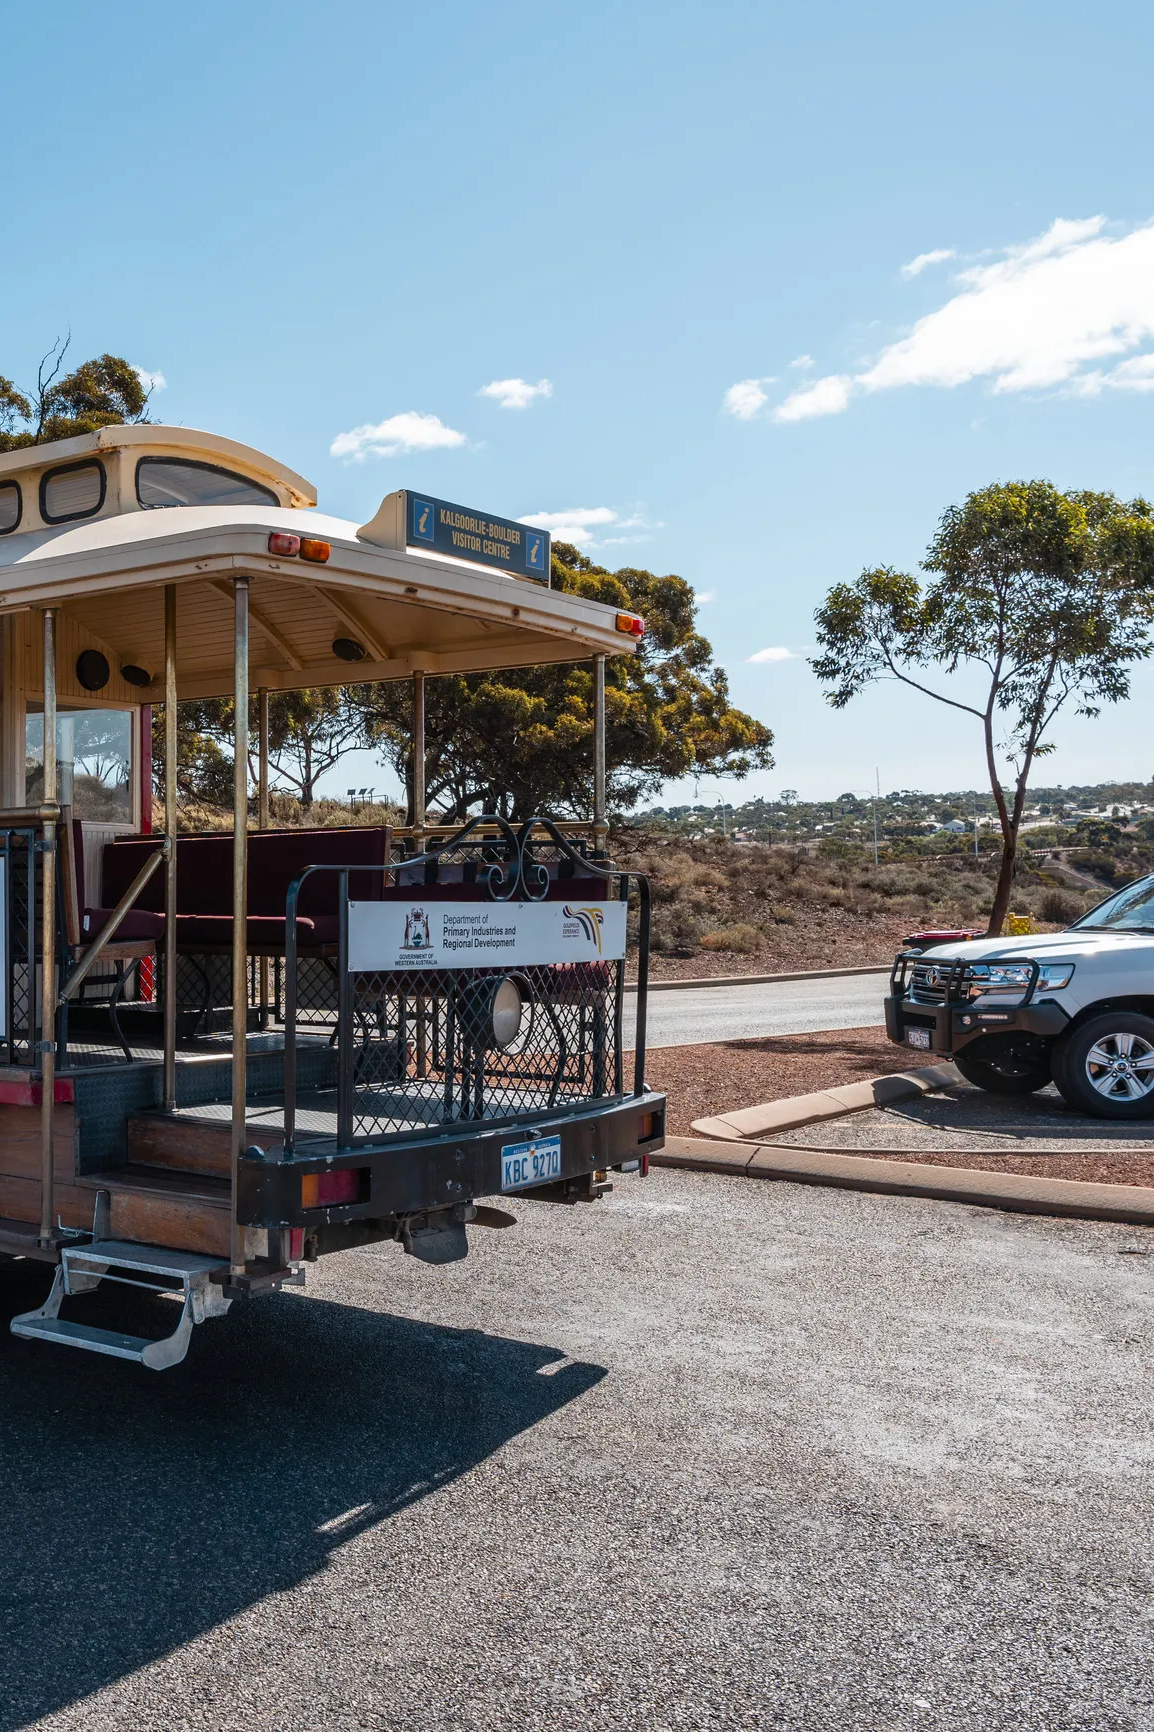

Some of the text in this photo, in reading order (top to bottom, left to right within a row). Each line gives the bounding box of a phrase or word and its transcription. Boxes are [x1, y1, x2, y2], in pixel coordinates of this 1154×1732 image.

[440, 508, 521, 545] KALGOORLIE-BOULDER
[452, 531, 510, 560] VISITOR CENTRE
[443, 914, 489, 926] Department of
[443, 925, 516, 938] Primary Industries and
[443, 938, 515, 950] Regional Development
[505, 1157, 529, 1185] KBC
